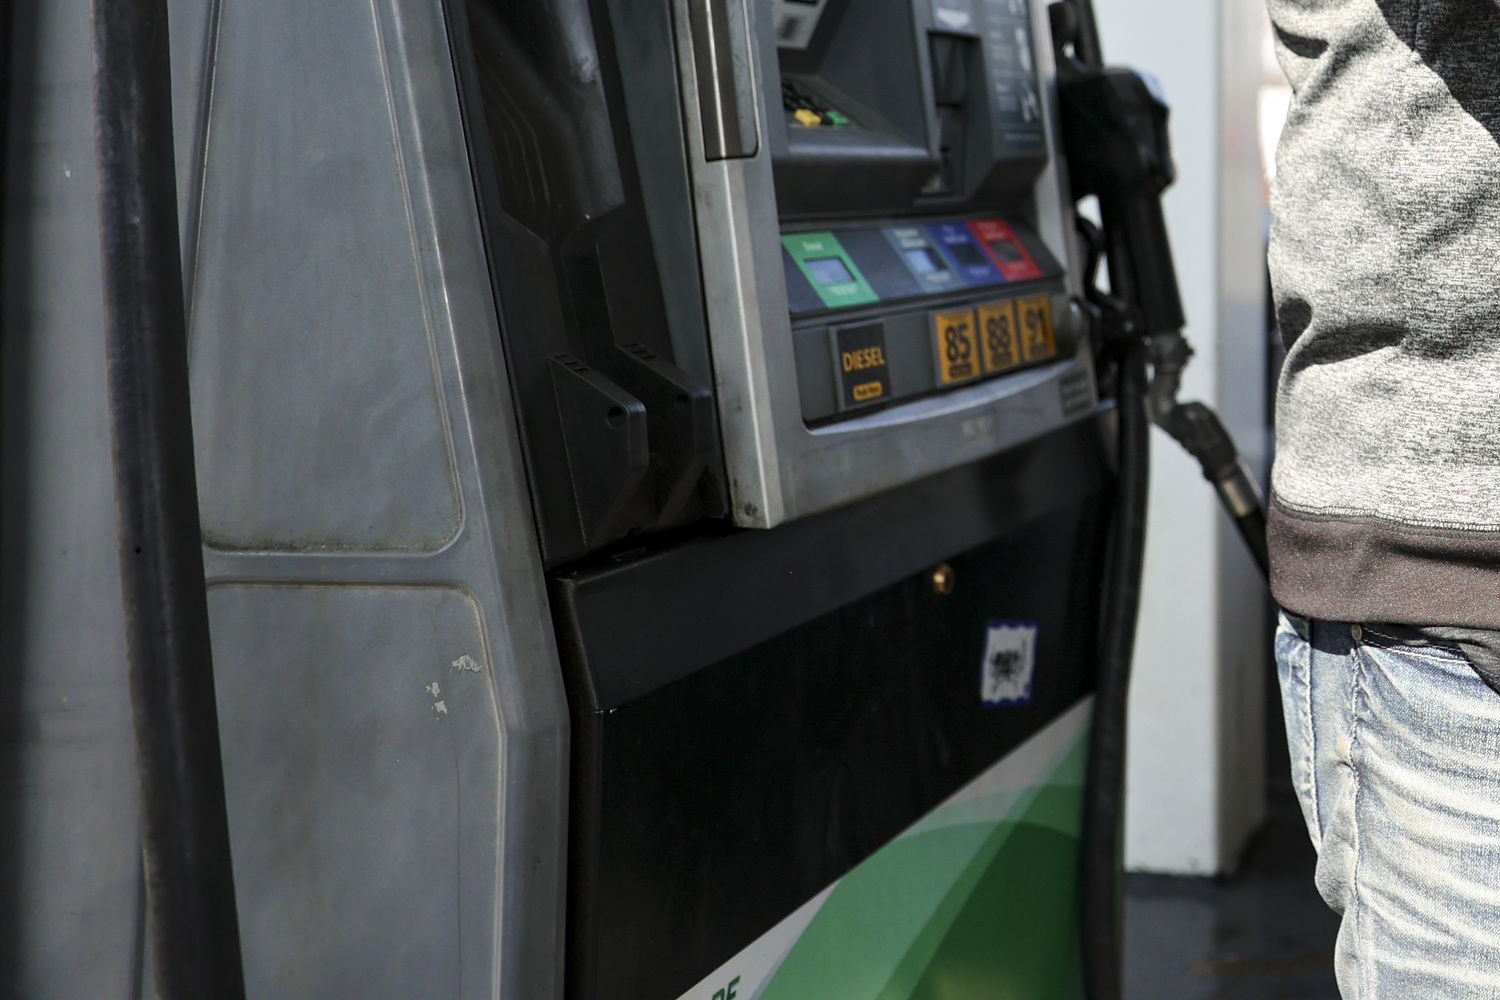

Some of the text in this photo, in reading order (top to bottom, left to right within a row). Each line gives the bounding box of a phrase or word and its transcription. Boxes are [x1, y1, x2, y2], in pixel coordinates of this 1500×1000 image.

[945, 323, 971, 361] 85
[987, 314, 1011, 352] 88
[842, 346, 886, 373] DIESEL
